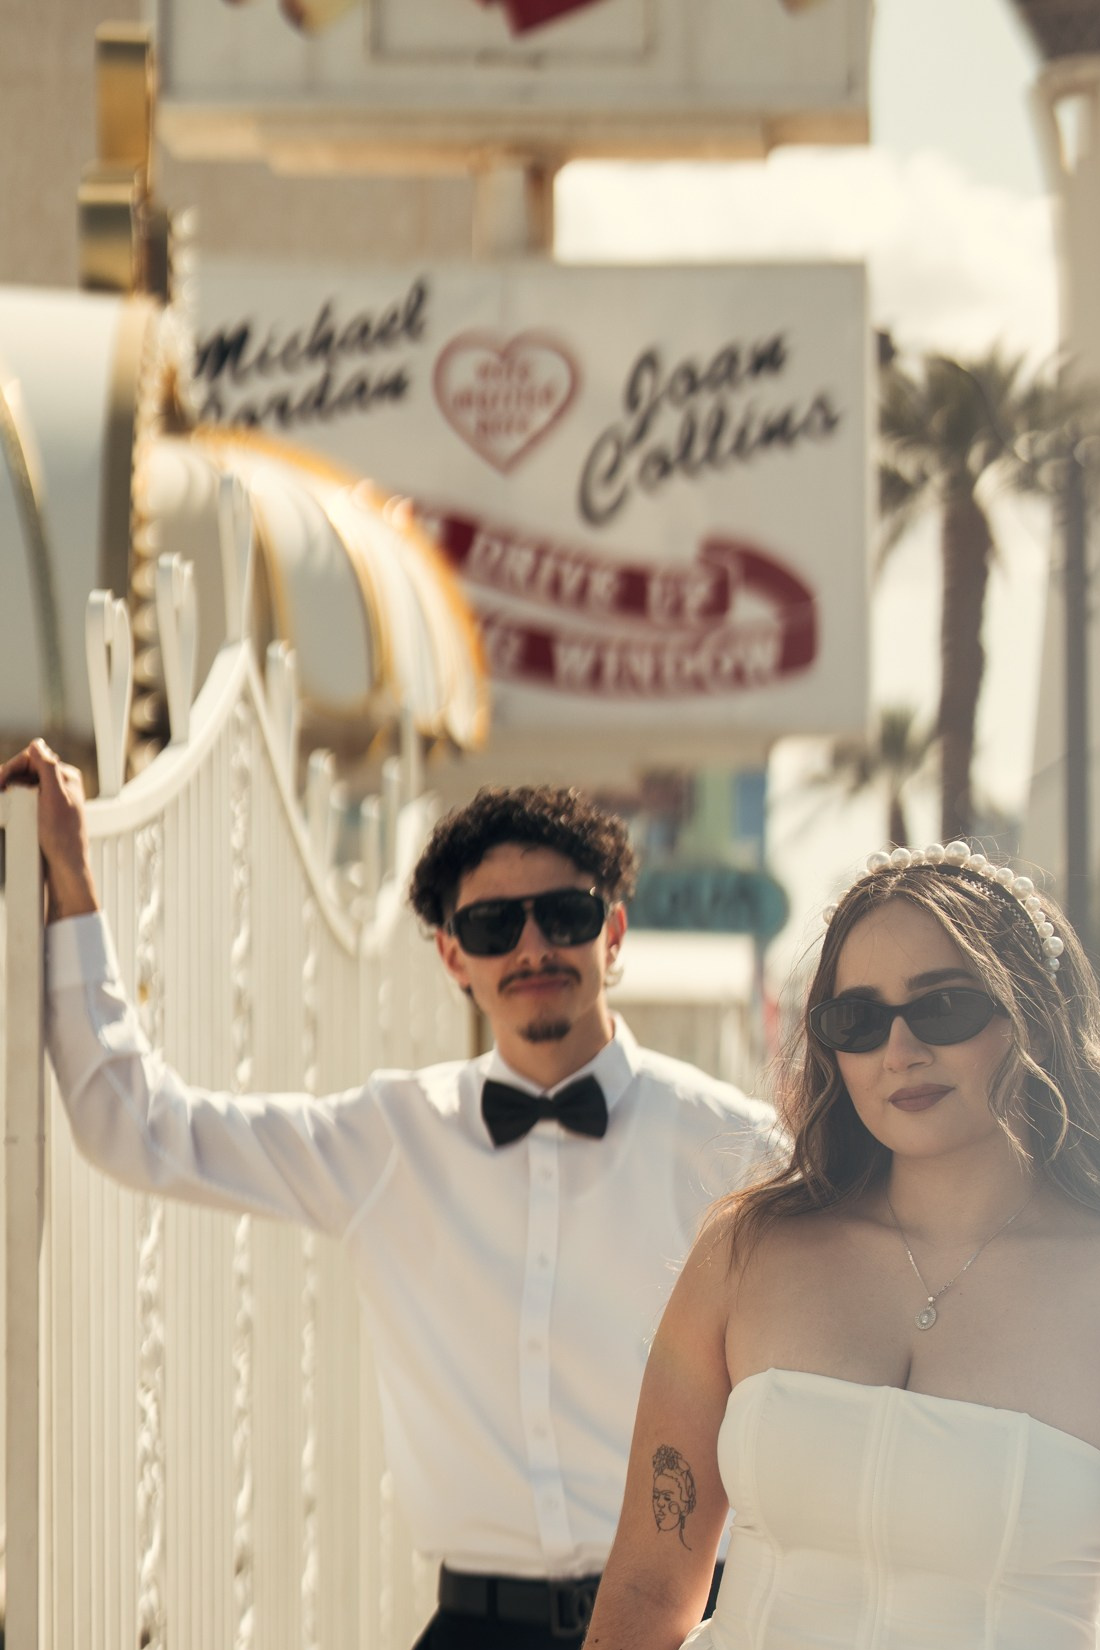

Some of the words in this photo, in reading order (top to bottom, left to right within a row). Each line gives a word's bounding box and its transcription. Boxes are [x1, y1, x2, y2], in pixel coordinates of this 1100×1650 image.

[192, 272, 430, 386] Michael
[622, 332, 788, 455] Joan
[576, 388, 842, 530] Collins
[466, 528, 619, 612] DRIVE
[555, 637, 777, 694] WINDOW
